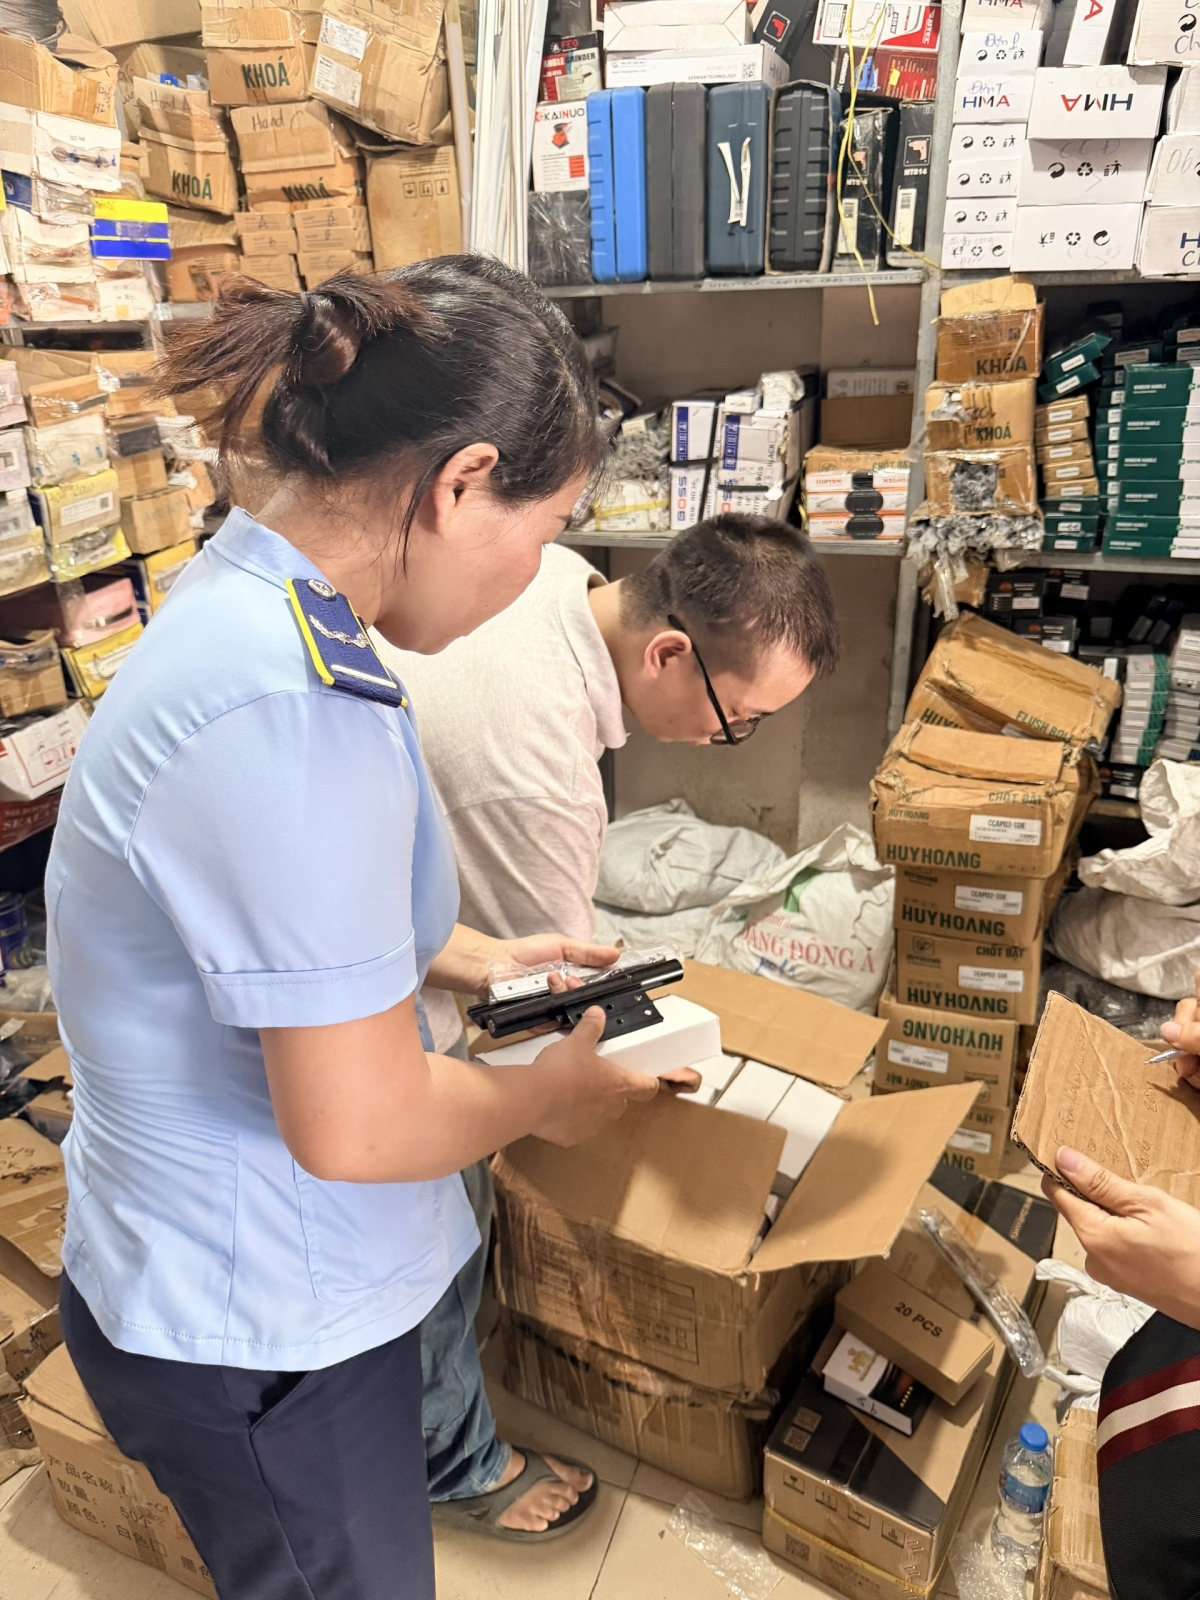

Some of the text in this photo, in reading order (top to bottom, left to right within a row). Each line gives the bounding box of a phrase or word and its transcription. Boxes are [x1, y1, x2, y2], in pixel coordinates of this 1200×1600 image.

[560, 38, 580, 49] FEG
[241, 55, 290, 89] KHOÁ
[544, 107, 585, 121] KAINUO
[962, 95, 1011, 109] HMA
[1061, 92, 1134, 113] HMA
[251, 108, 284, 131] Hand
[172, 170, 213, 201] KHOÁ
[282, 177, 332, 201] KHOÁ
[975, 422, 1012, 441] KHOÁ
[677, 476, 687, 521] BOSS
[1015, 710, 1050, 733] FLUSH
[888, 808, 930, 820] HUYHOANG
[886, 843, 981, 870] HUYHOANG
[901, 904, 1006, 937] HUYHOANG
[789, 936, 854, 970] ĐÔNG
[906, 987, 1008, 1014] HUYHOANG
[902, 1019, 1003, 1051] HUYHOANG
[894, 1301, 943, 1338] 20 PCS
